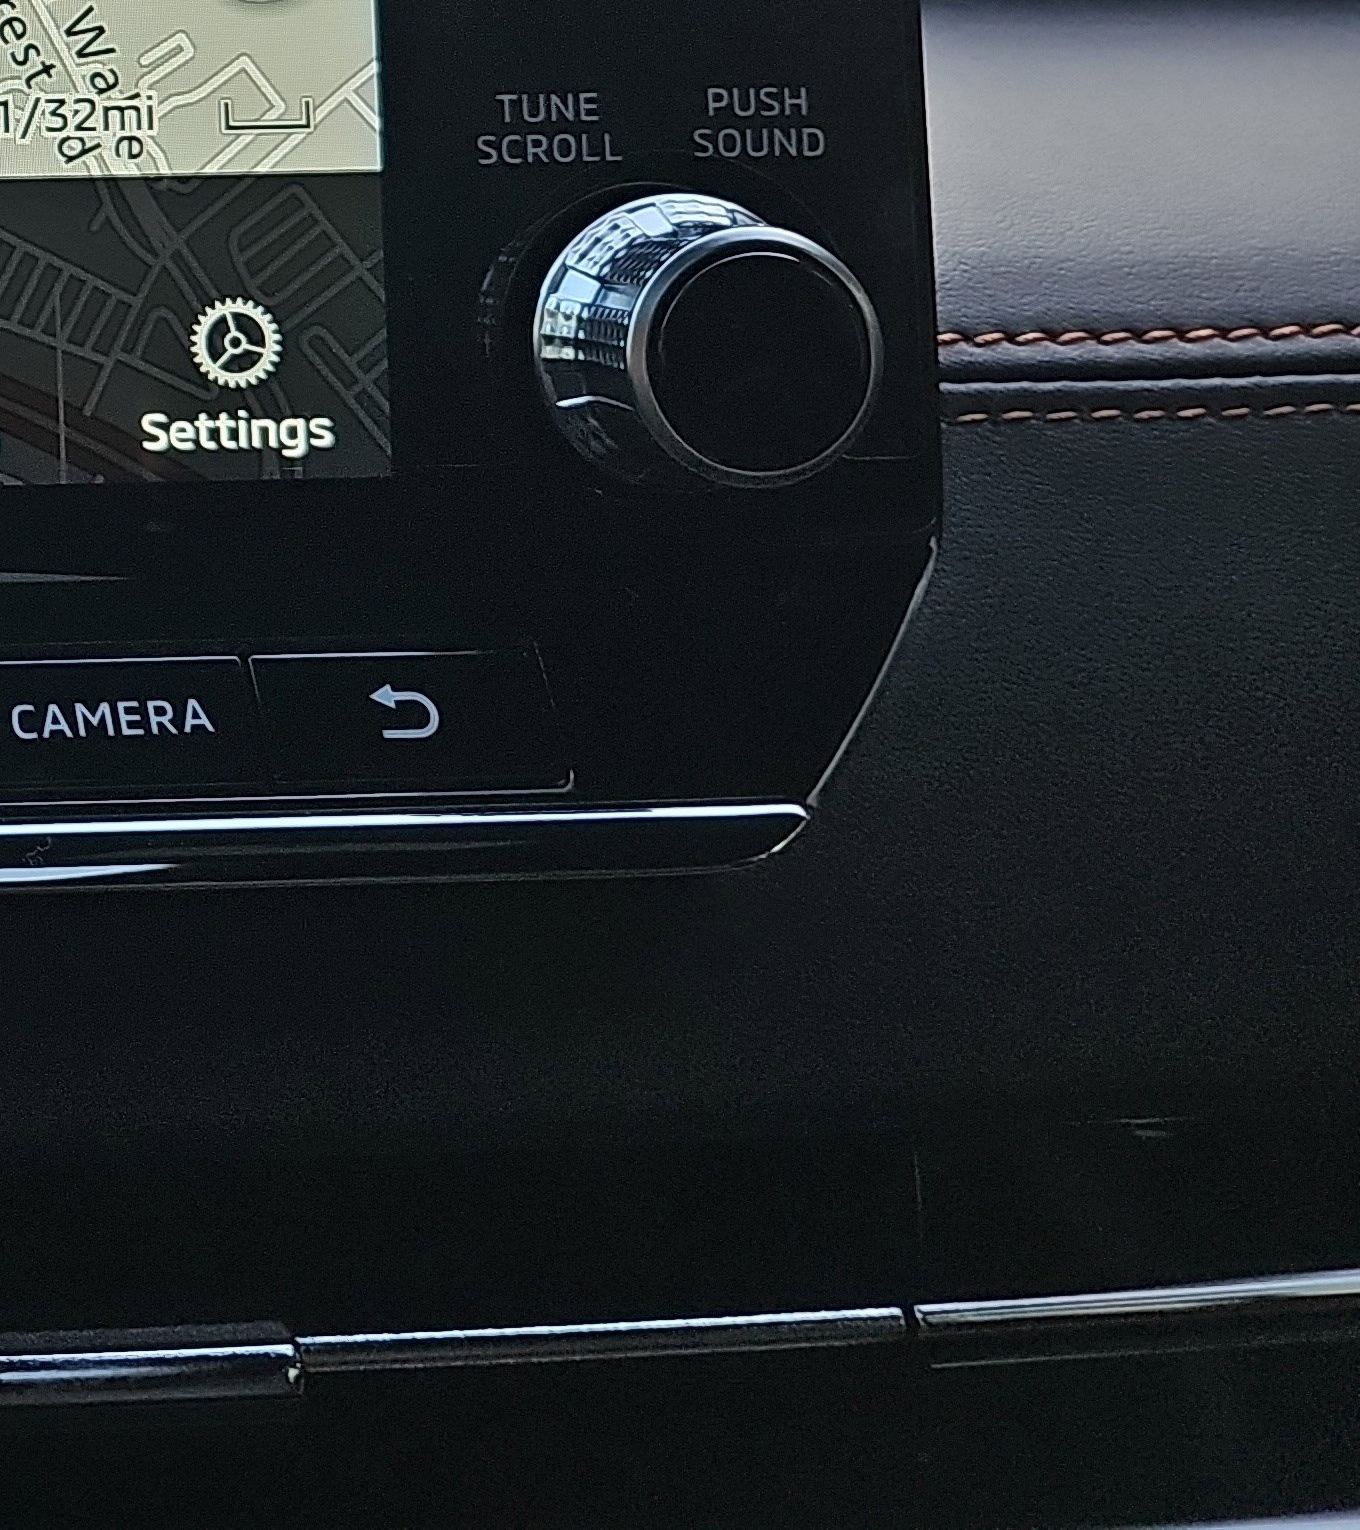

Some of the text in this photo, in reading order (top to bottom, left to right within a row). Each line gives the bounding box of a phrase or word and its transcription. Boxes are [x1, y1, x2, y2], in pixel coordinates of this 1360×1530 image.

[64, 6, 144, 160] Wae
[495, 93, 600, 122] TUNE
[707, 87, 808, 117] PUSH
[476, 132, 622, 164] SCROLL
[693, 128, 825, 158] SOUND
[141, 411, 335, 458] Settings
[10, 698, 216, 740] CAMERA
